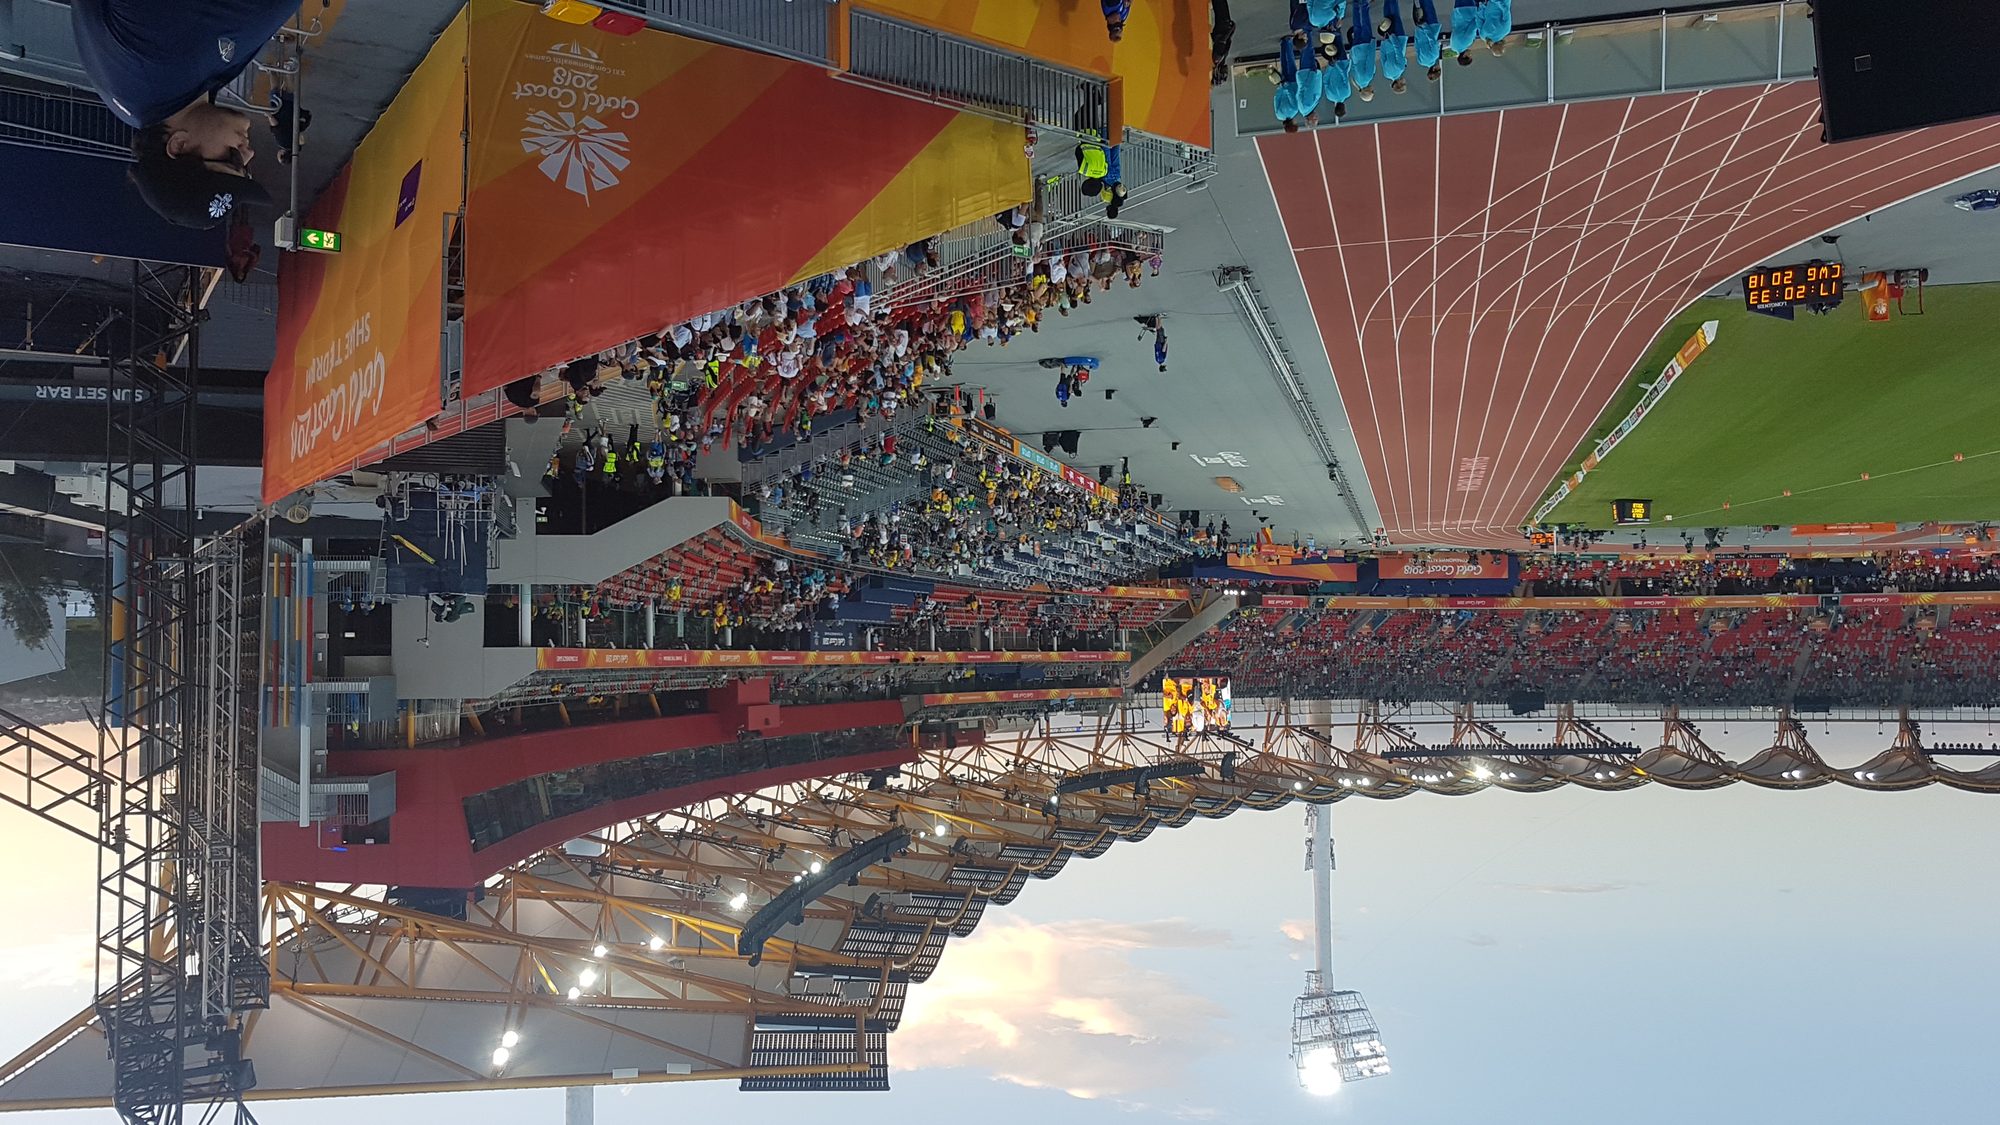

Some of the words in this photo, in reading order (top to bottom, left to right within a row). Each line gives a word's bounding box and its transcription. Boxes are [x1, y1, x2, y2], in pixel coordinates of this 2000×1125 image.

[553, 56, 612, 74] Commonwealth
[552, 67, 599, 91] 2018
[512, 81, 577, 108] Coast
[582, 91, 639, 119] Gold
[1749, 270, 1793, 289] 2018
[1807, 265, 1841, 281] CWG
[35, 385, 72, 399] BAR
[75, 387, 143, 402] SUNSET
[347, 347, 385, 432] Gold
[311, 383, 346, 449] Coast
[1427, 565, 1454, 575] Coast
[1457, 564, 1482, 575] Gold
